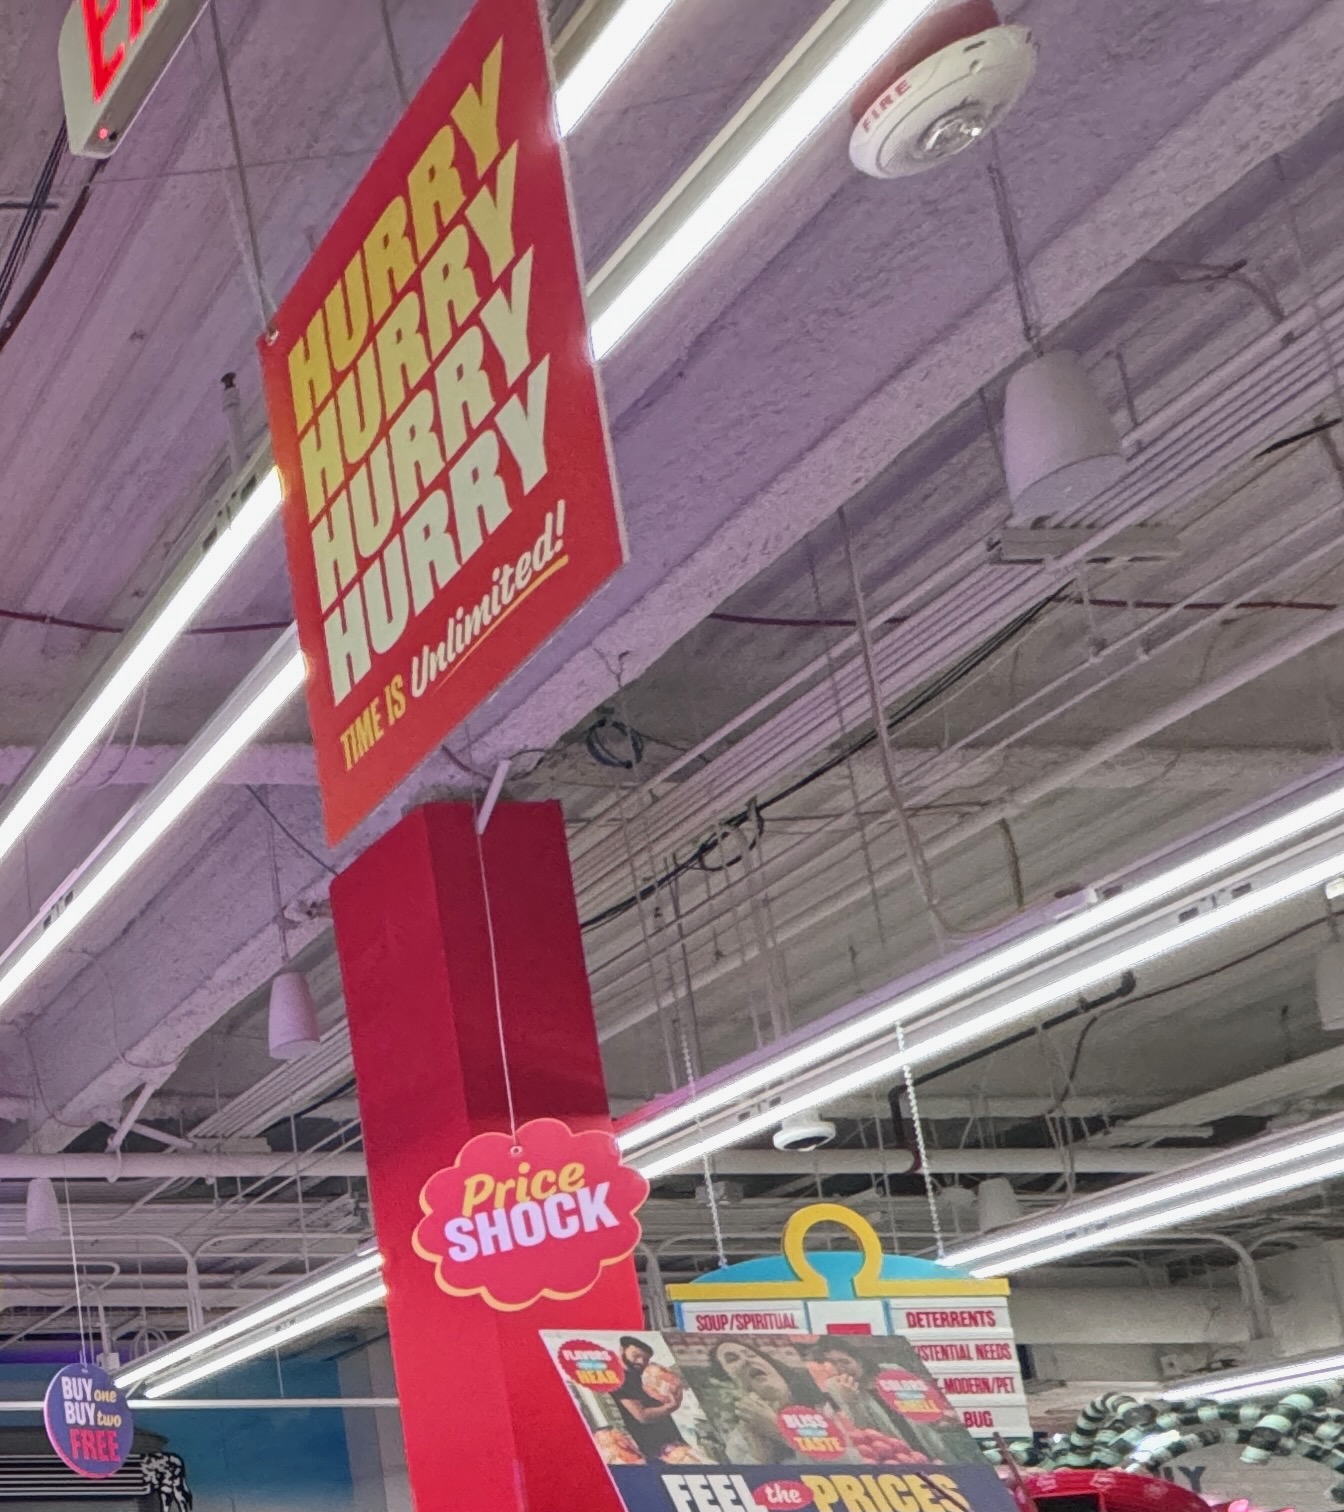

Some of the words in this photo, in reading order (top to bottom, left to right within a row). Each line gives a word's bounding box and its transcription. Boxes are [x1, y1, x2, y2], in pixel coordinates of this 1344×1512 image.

[288, 37, 505, 431] HURRY
[299, 141, 520, 523] HURRY
[311, 245, 535, 614] HURRY
[323, 355, 550, 707] HURRY
[339, 709, 384, 772] TIME
[385, 674, 408, 724] IS
[410, 501, 567, 697] Unlimited!
[462, 1157, 586, 1217] Price
[444, 1182, 619, 1262] SHOCK
[695, 1314, 799, 1332] SOUP/SPIRITUAL
[906, 1311, 996, 1328] DETERRENTS
[915, 1344, 973, 1361] ISTENTIAL
[976, 1342, 1012, 1360] NEEDS
[61, 1376, 93, 1401] BUY
[94, 1389, 117, 1403] one
[936, 1376, 1016, 1394] -MODERN/PET
[64, 1401, 95, 1426] BUY
[97, 1410, 122, 1427] two
[963, 1411, 993, 1427] BUG
[69, 1428, 121, 1462] FREE
[764, 1483, 803, 1505] the
